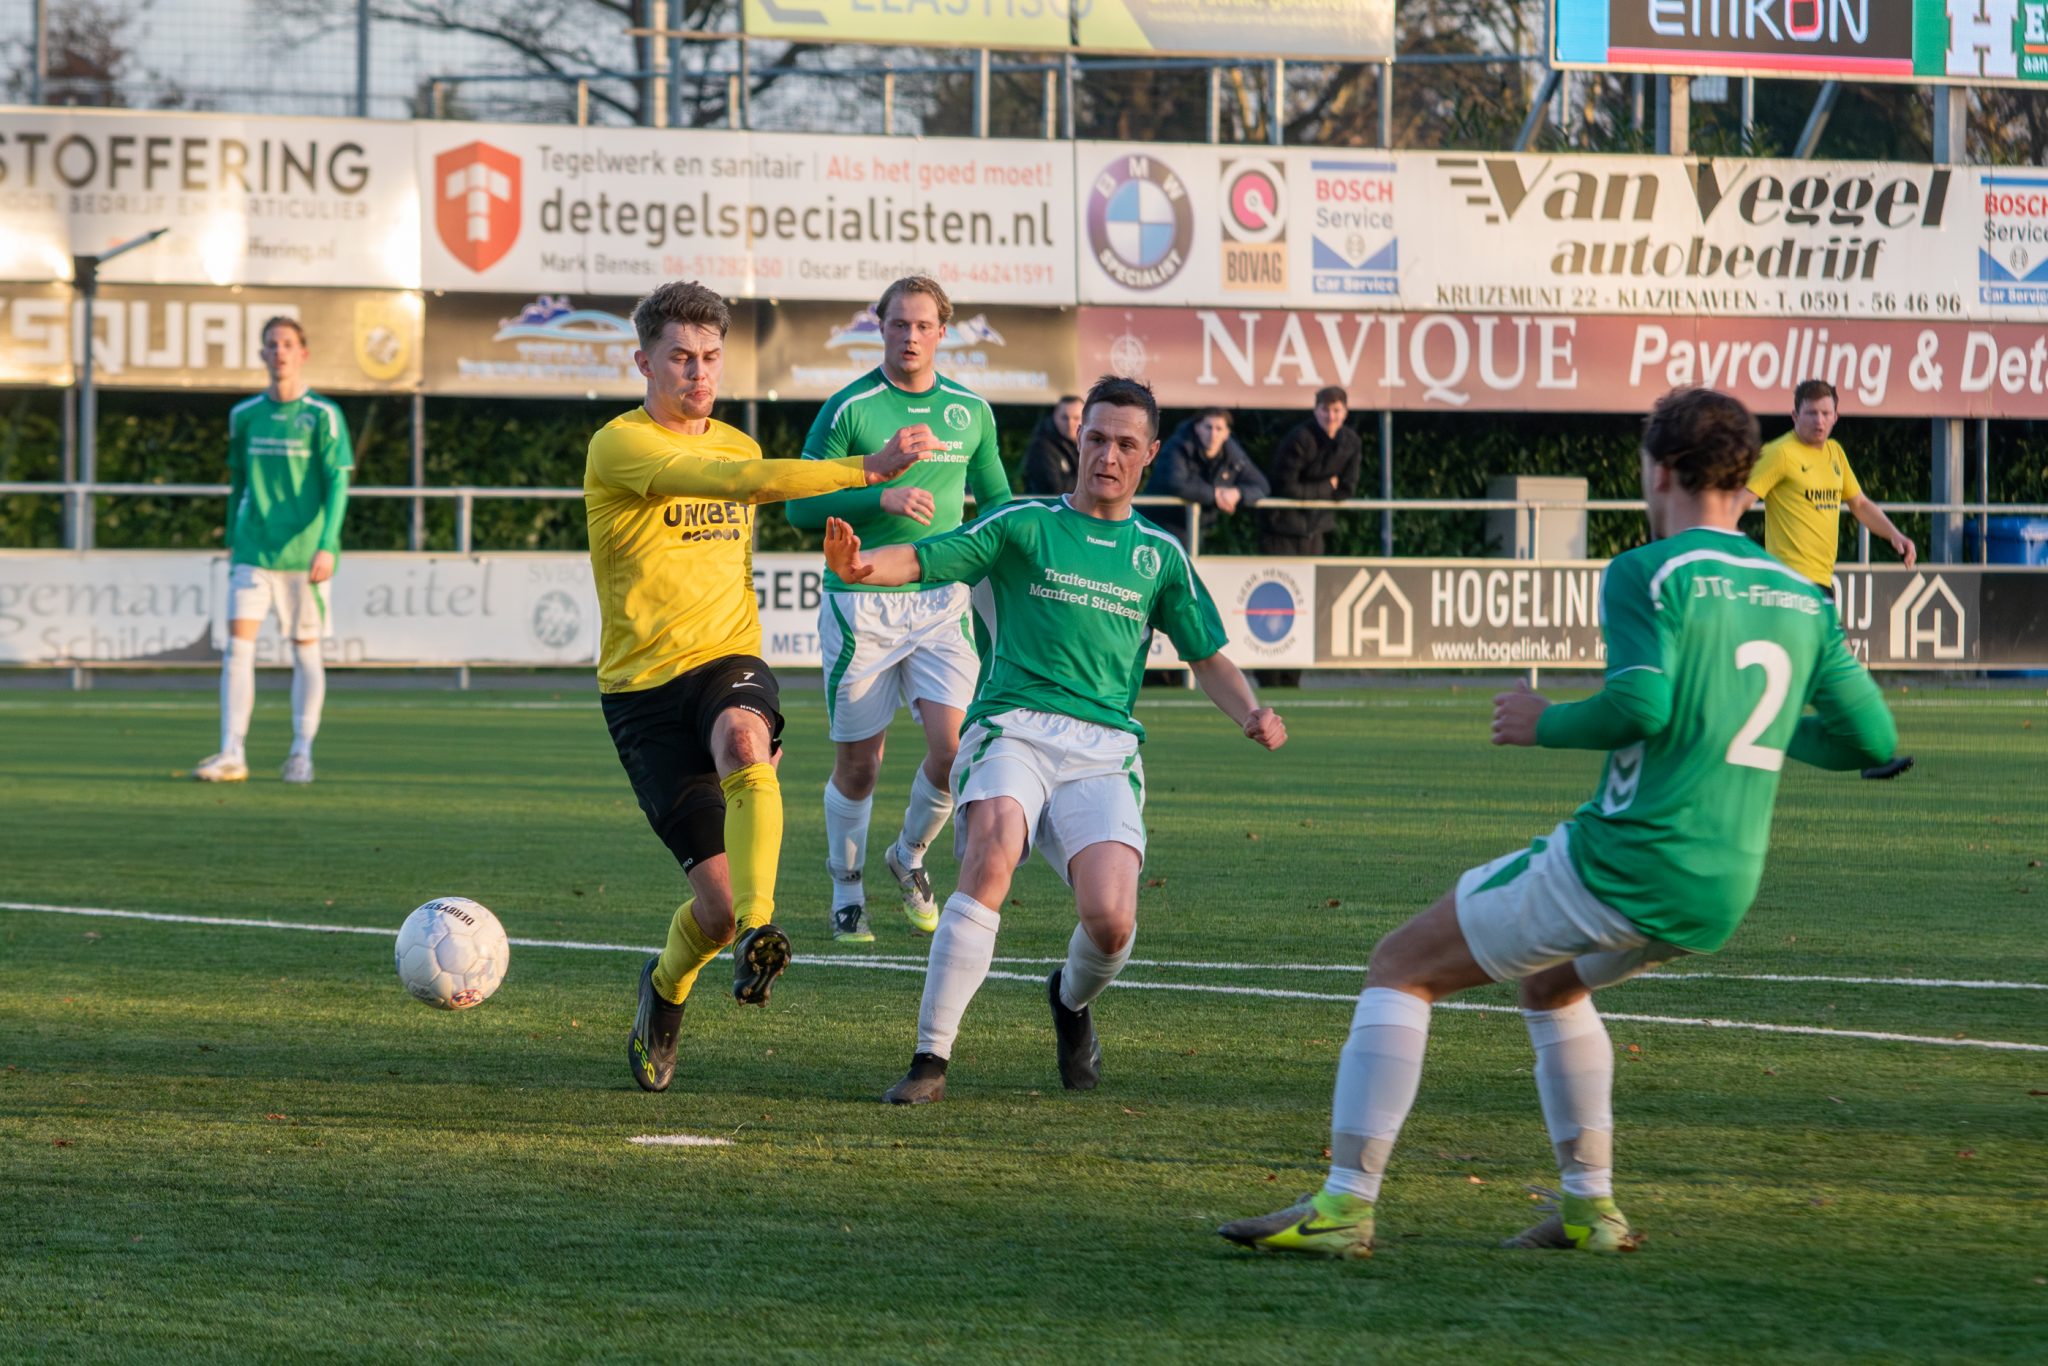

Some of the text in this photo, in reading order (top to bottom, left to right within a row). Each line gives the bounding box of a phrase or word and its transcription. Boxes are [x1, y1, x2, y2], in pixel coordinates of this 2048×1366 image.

[539, 146, 1052, 190] Tegelwerk en sanitair Als het goed moet!
[1316, 179, 1393, 202] BOSCH
[1483, 158, 1951, 228] Van Veggel
[541, 188, 1053, 248] detegelspecialisten.nl
[1317, 207, 1392, 230] Service
[541, 254, 587, 274] Mark
[799, 260, 851, 280] Oscar
[1227, 251, 1282, 283] BOVAG
[1550, 235, 1886, 282] autobedrijf
[1572, 287, 1597, 307] 22
[1800, 291, 1849, 312] 0591
[1871, 292, 1896, 313] 56
[1904, 293, 1928, 313] 46
[1936, 294, 1961, 315] 96
[1197, 312, 2048, 407] NAVIQUE Payrolling & Det
[664, 501, 751, 527] UNIBET
[1029, 583, 1088, 606] Manfred
[1045, 568, 1142, 602] Traiteurslager
[1432, 637, 1571, 663] www.hogelink.nl
[743, 672, 755, 680] 7
[1725, 640, 1792, 772] 2
